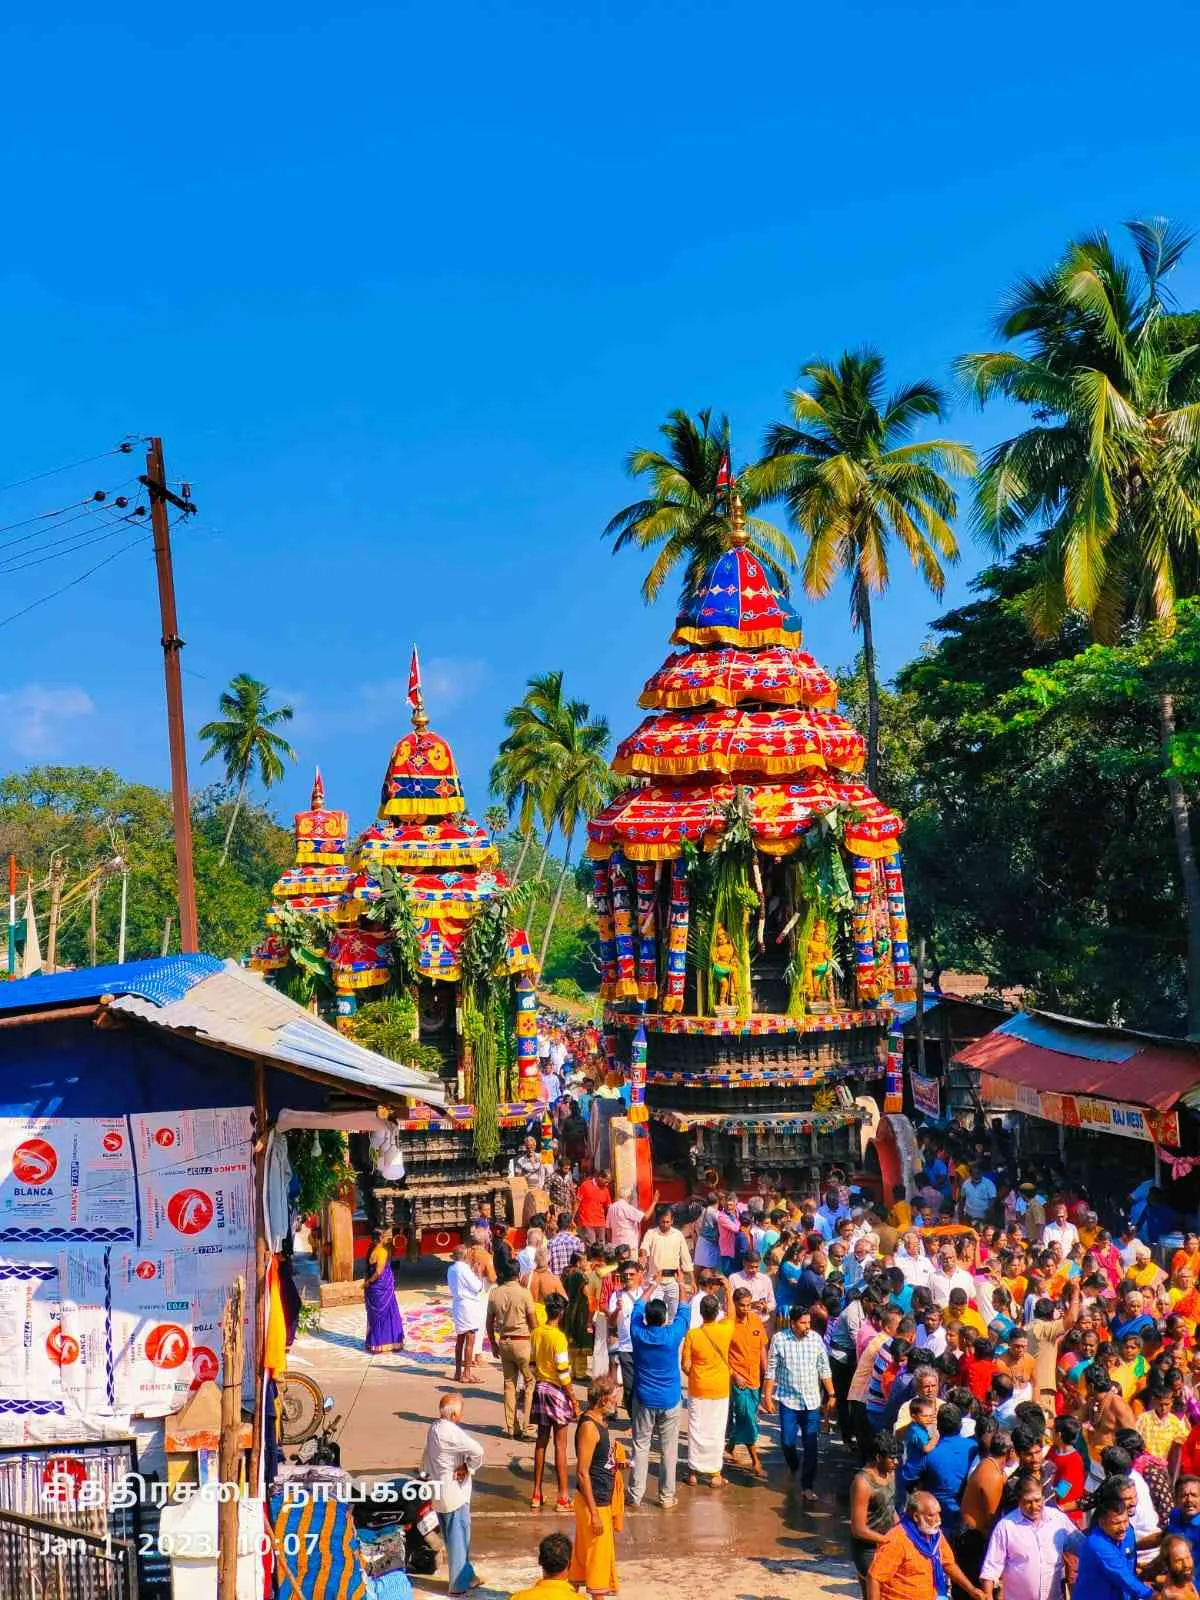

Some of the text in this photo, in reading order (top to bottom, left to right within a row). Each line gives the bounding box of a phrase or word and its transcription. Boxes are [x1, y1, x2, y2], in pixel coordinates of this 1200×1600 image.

[1112, 1109, 1125, 1125] RAJ
[214, 1164, 247, 1174] BLANCA
[14, 1187, 54, 1196] BLANCA
[70, 1188, 78, 1221] BLANCA
[215, 1190, 225, 1229] BLANCA
